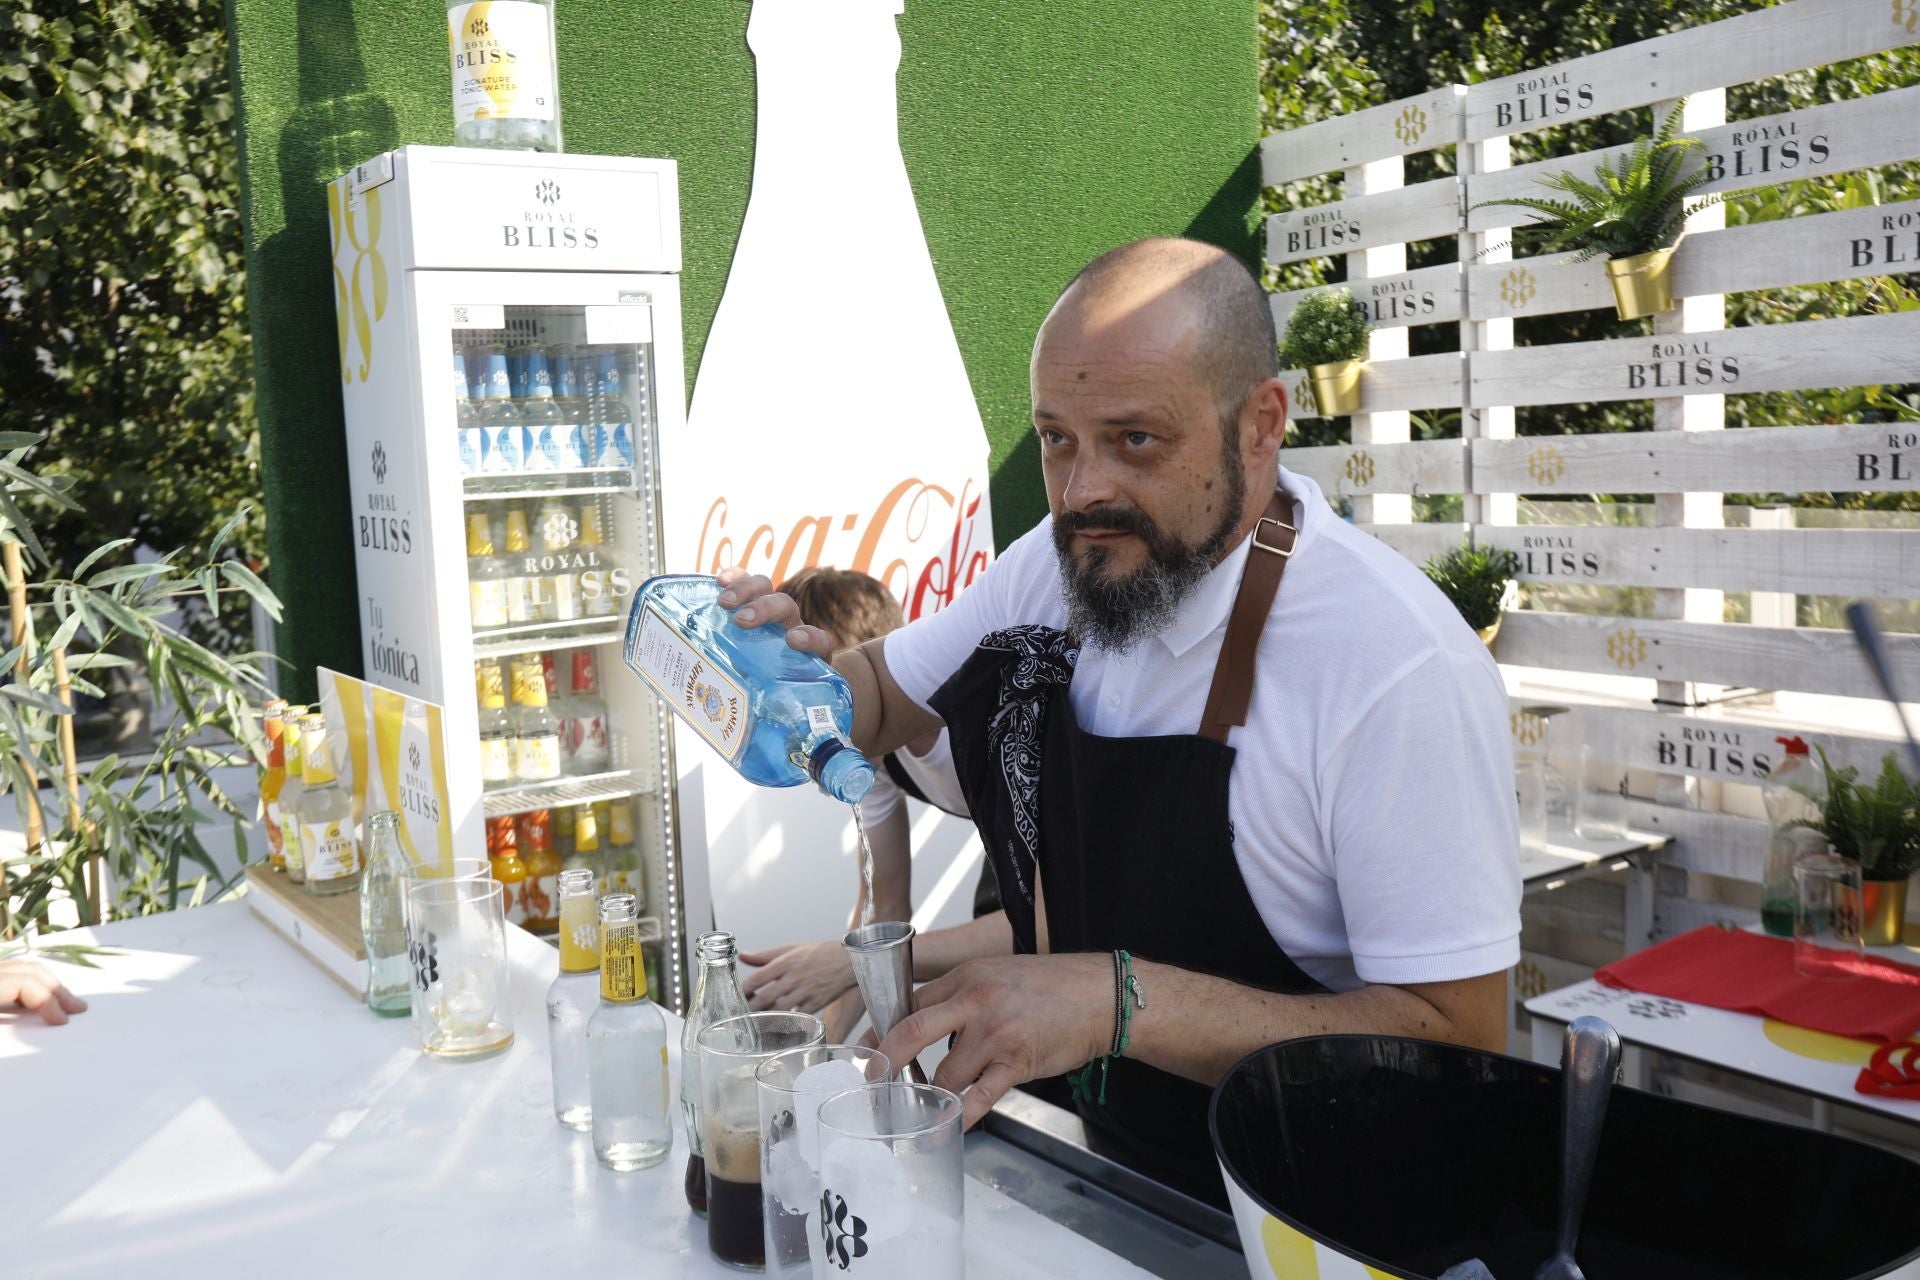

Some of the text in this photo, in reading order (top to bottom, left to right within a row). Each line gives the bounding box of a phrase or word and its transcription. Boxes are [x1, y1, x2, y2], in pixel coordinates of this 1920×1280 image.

[465, 40, 500, 50] ROYAL
[456, 48, 517, 69] BLISS
[461, 83, 517, 95] TONIC WATER
[464, 76, 511, 87] SIGNATURE
[1516, 71, 1570, 95] ROYAL
[1495, 83, 1594, 128] BLISS
[1732, 121, 1800, 147] ROYAL
[1706, 135, 1830, 182] BLISS
[524, 211, 575, 223] ROYAL
[1303, 209, 1343, 226] ROYAL
[502, 225, 599, 249] BLISS
[1287, 220, 1361, 253] BLISS
[1371, 279, 1415, 296] ROYAL
[1355, 291, 1435, 322] BLISS
[1652, 341, 1711, 358] ROYAL
[1628, 357, 1740, 388] BLISS
[368, 493, 397, 512] ROYAL
[359, 515, 412, 554] BLISS
[1523, 536, 1576, 548] ROYAL
[525, 551, 600, 573] ROYAL
[1505, 551, 1599, 577] BLISS
[367, 597, 383, 629] Tu
[371, 632, 420, 686] tónica
[686, 661, 704, 710] SAPPHIRE
[1682, 726, 1744, 746] ROYAL
[1657, 740, 1771, 779] BLISS
[406, 772, 428, 793] ROYAL
[400, 785, 439, 824] BLISS
